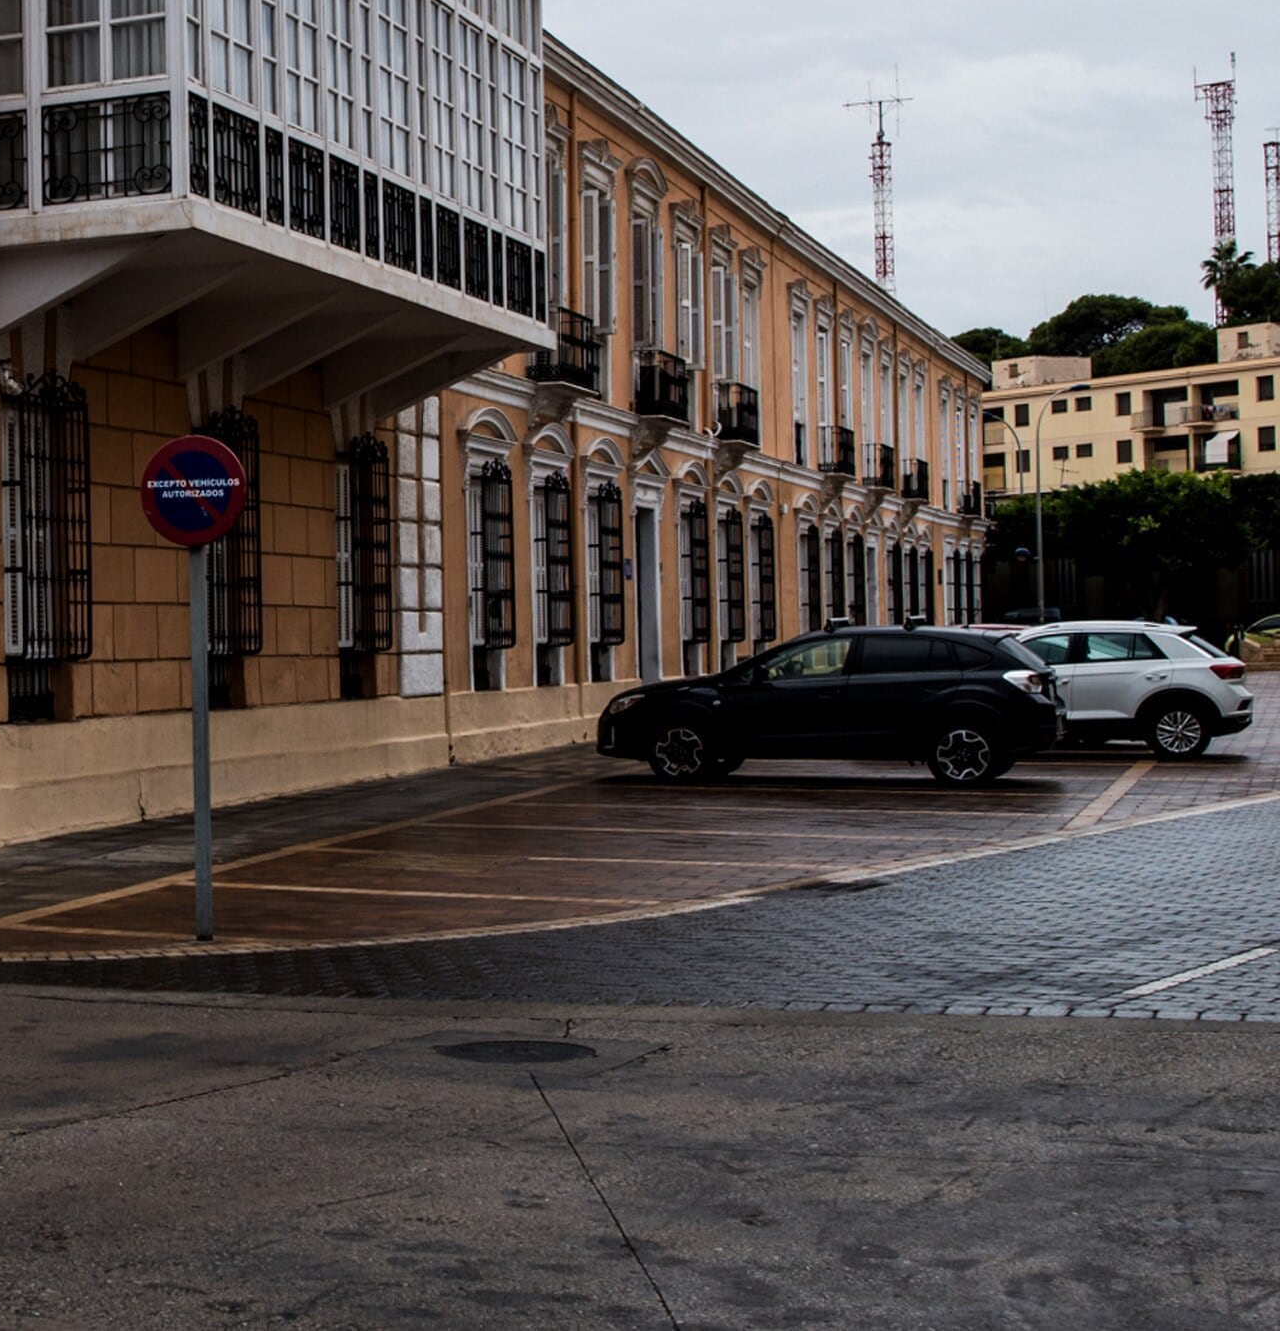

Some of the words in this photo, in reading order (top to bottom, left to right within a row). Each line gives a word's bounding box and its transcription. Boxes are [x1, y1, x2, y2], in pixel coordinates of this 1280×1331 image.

[146, 479, 187, 489] EXCEPTO
[188, 477, 240, 488] VEHÍCULOS
[162, 489, 224, 499] AUTORIZADOS
